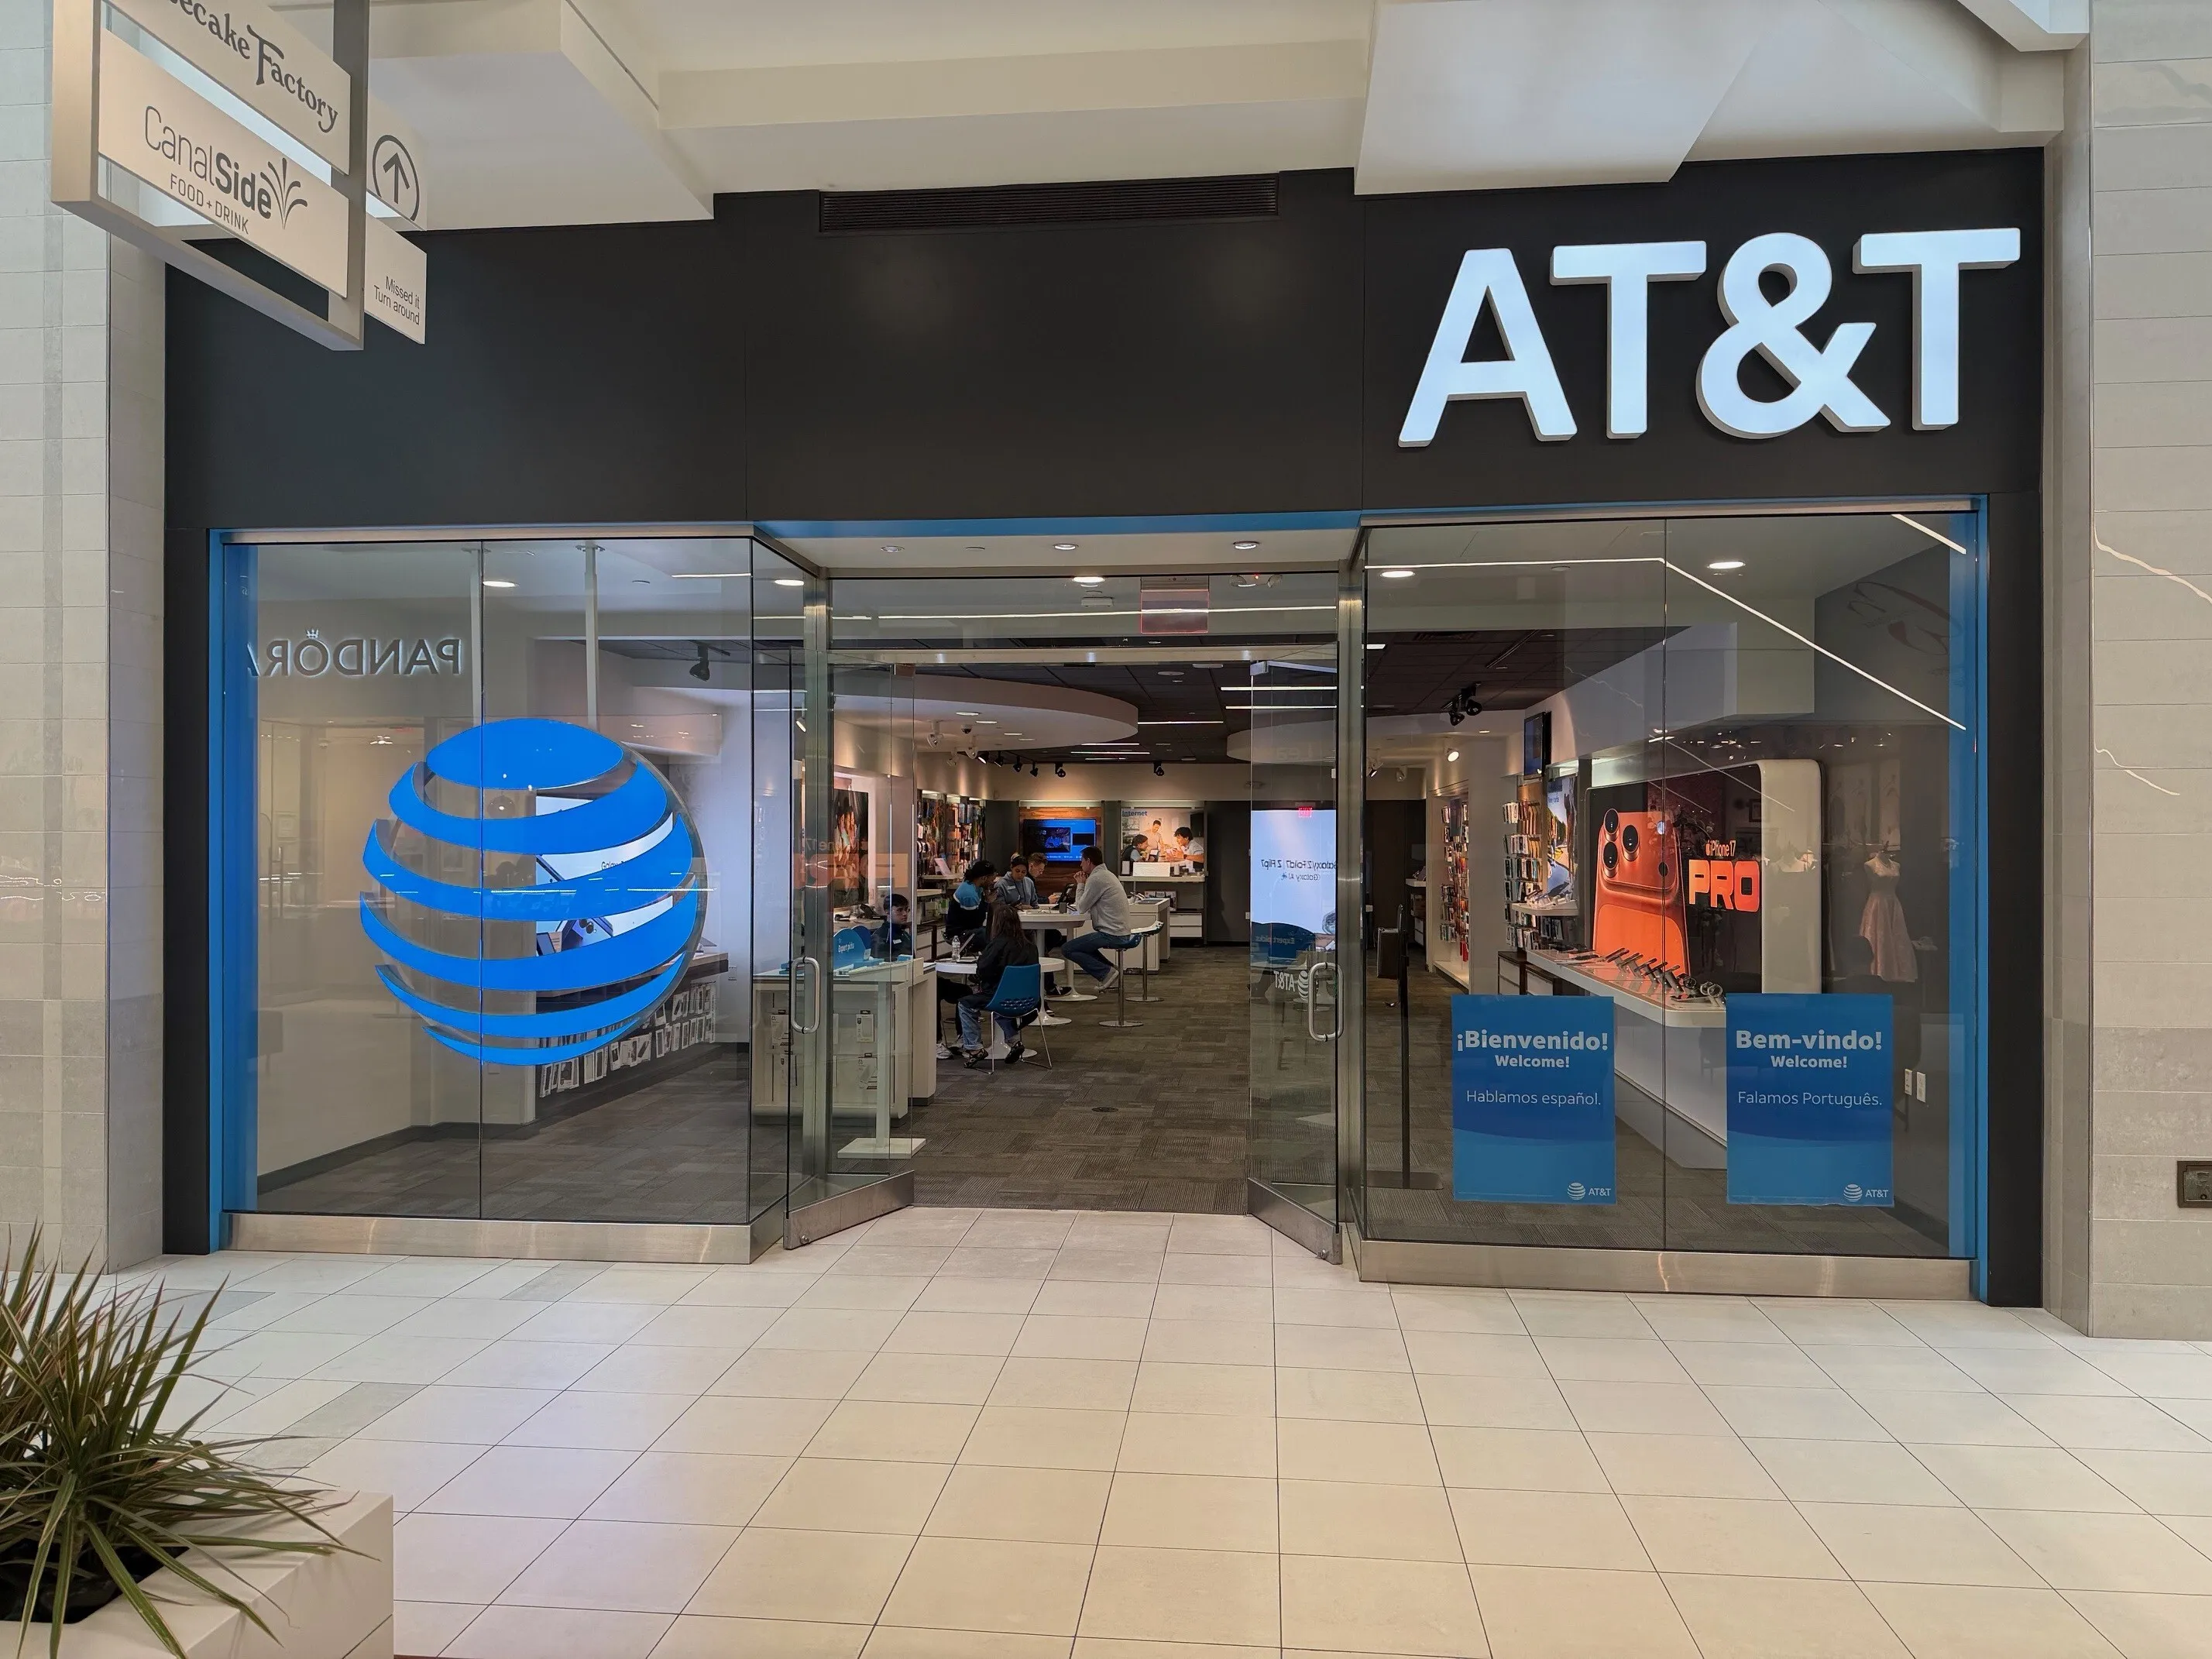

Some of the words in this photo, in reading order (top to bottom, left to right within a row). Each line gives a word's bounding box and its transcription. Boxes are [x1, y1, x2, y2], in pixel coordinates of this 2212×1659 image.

[170, 0, 250, 60] ecake
[246, 24, 338, 133] Factory
[145, 105, 271, 219] CanalSide
[170, 173, 204, 208] FOOD
[215, 200, 249, 235] DRINK
[386, 275, 413, 305] Missed
[415, 294, 420, 309] it
[373, 284, 391, 307] Turn
[393, 301, 420, 325] around
[1397, 227, 2021, 448] AT&T
[1709, 840, 1729, 857] iPhone
[1729, 840, 1736, 857] 17
[1688, 859, 1760, 912] PRO
[1457, 1029, 1608, 1052] ¡Bienvenido!
[1736, 1029, 1882, 1050] Bem-vindo!
[1494, 1054, 1570, 1068] Welcome!
[1770, 1054, 1847, 1069] Welcome!
[1466, 1090, 1538, 1104] Hablamos
[1541, 1092, 1601, 1108] español.
[1738, 1091, 1798, 1104] Falamos
[1802, 1092, 1882, 1108] Português.
[1588, 1187, 1611, 1197] AT&T
[1865, 1189, 1889, 1198] AT&T
